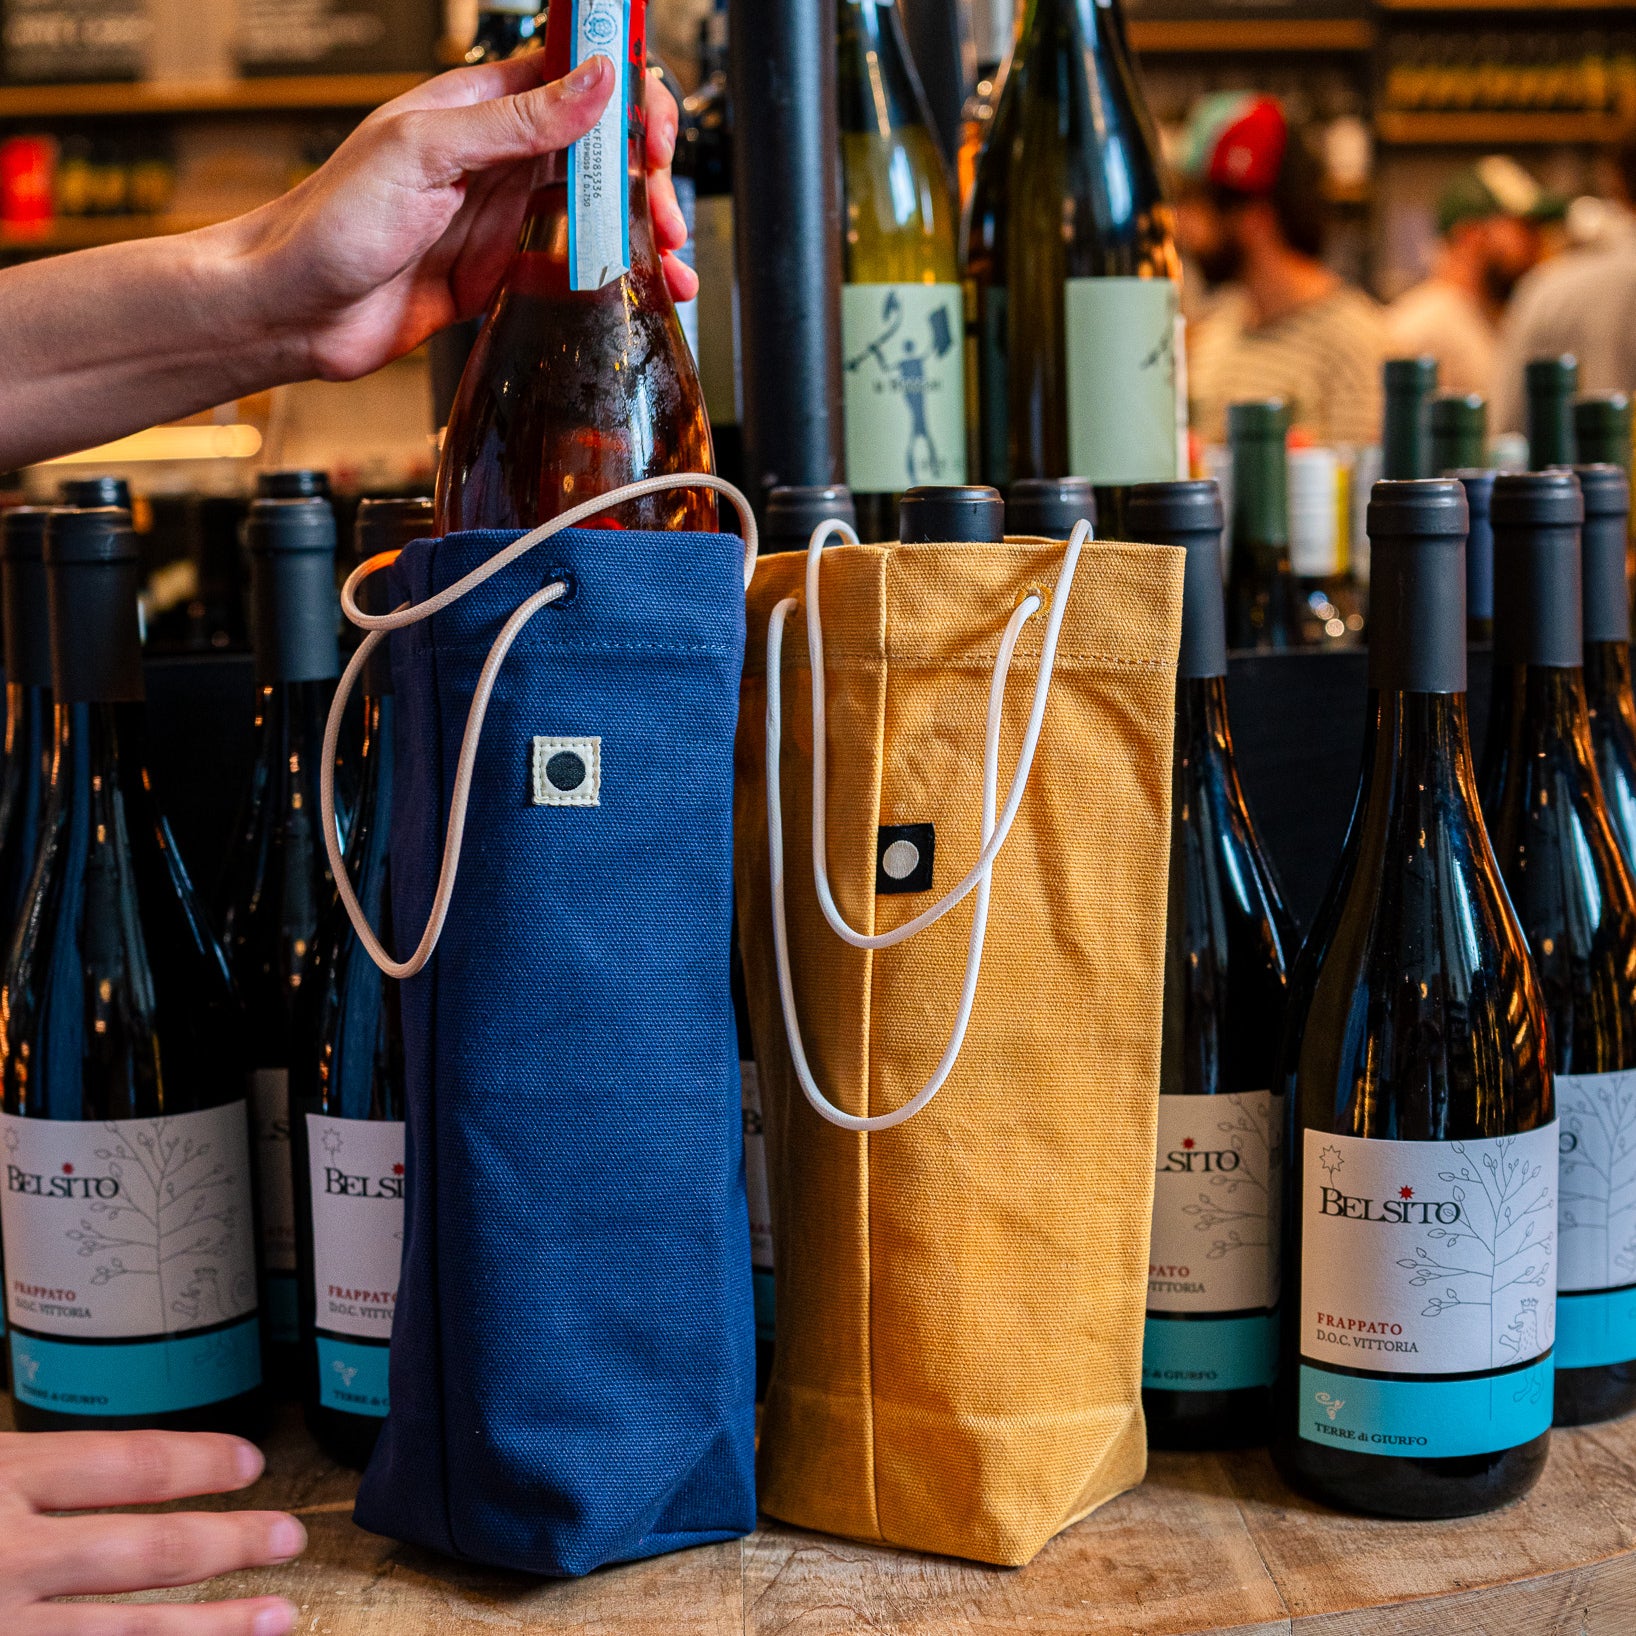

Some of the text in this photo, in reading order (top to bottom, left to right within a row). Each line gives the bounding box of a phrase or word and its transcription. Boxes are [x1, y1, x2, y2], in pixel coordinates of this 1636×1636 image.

[1156, 1149, 1241, 1172] SITO
[7, 1164, 120, 1199] BELSITO
[1318, 1185, 1461, 1225] BELSITO
[1317, 1312, 1403, 1336] FRAPPATO
[1316, 1329, 1419, 1353] D.O.C. VITTORIA
[1314, 1422, 1429, 1447] TERRE di GIURFO
